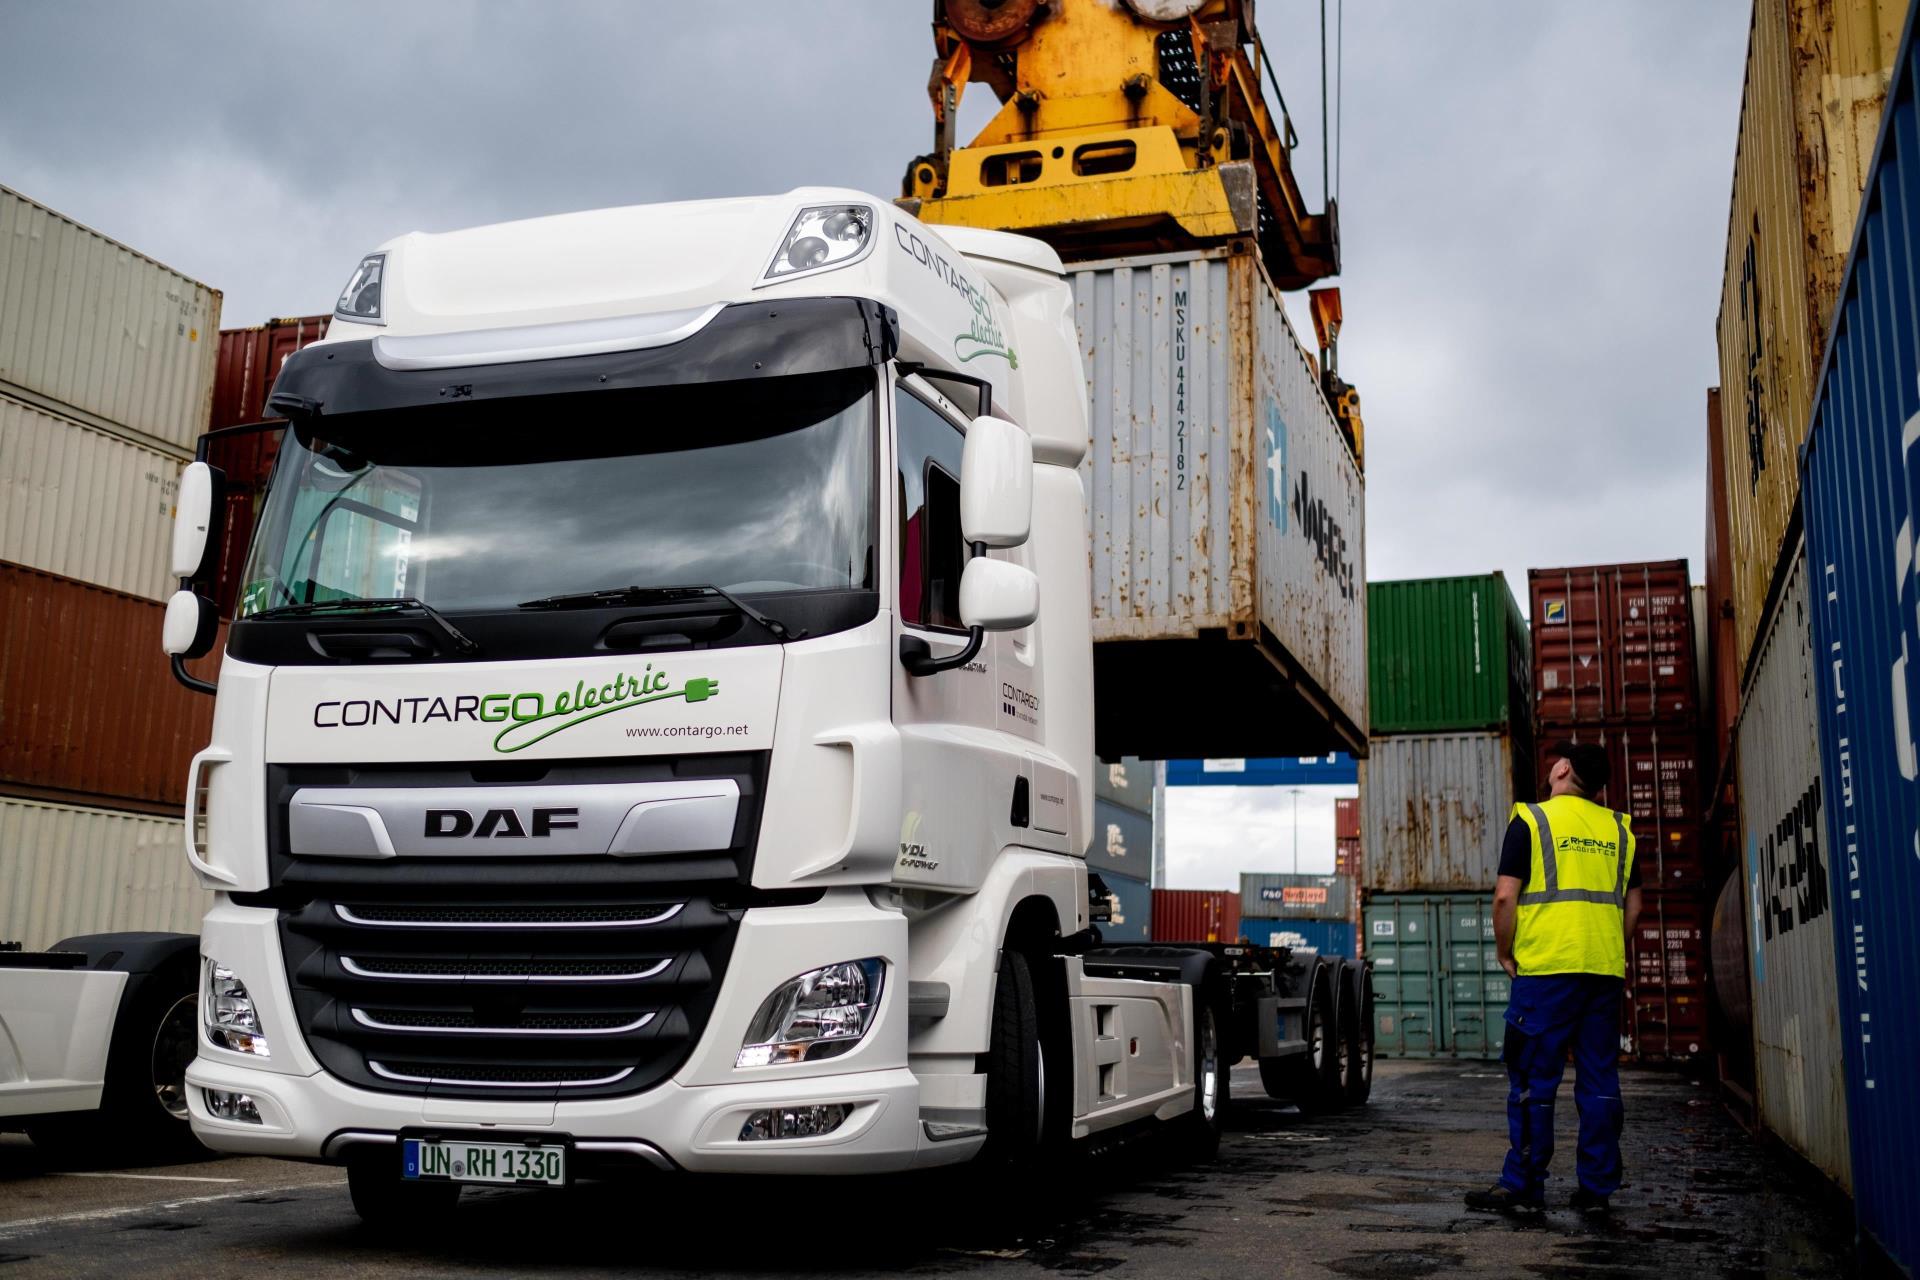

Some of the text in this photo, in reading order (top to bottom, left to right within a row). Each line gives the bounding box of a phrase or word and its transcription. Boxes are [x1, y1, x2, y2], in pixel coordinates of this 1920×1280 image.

[895, 222, 992, 325] CONTARGO
[971, 314, 1004, 349] electric
[314, 663, 670, 728] CONTARGO electric
[1003, 682, 1039, 711] CONTARGO
[626, 724, 749, 740] www.contargo.net
[424, 807, 579, 838] DAF
[1570, 836, 1616, 850] RHENUS
[1571, 845, 1616, 857] LOGISTCS
[408, 1163, 415, 1172] D
[421, 1146, 560, 1180] UN RH 1330
